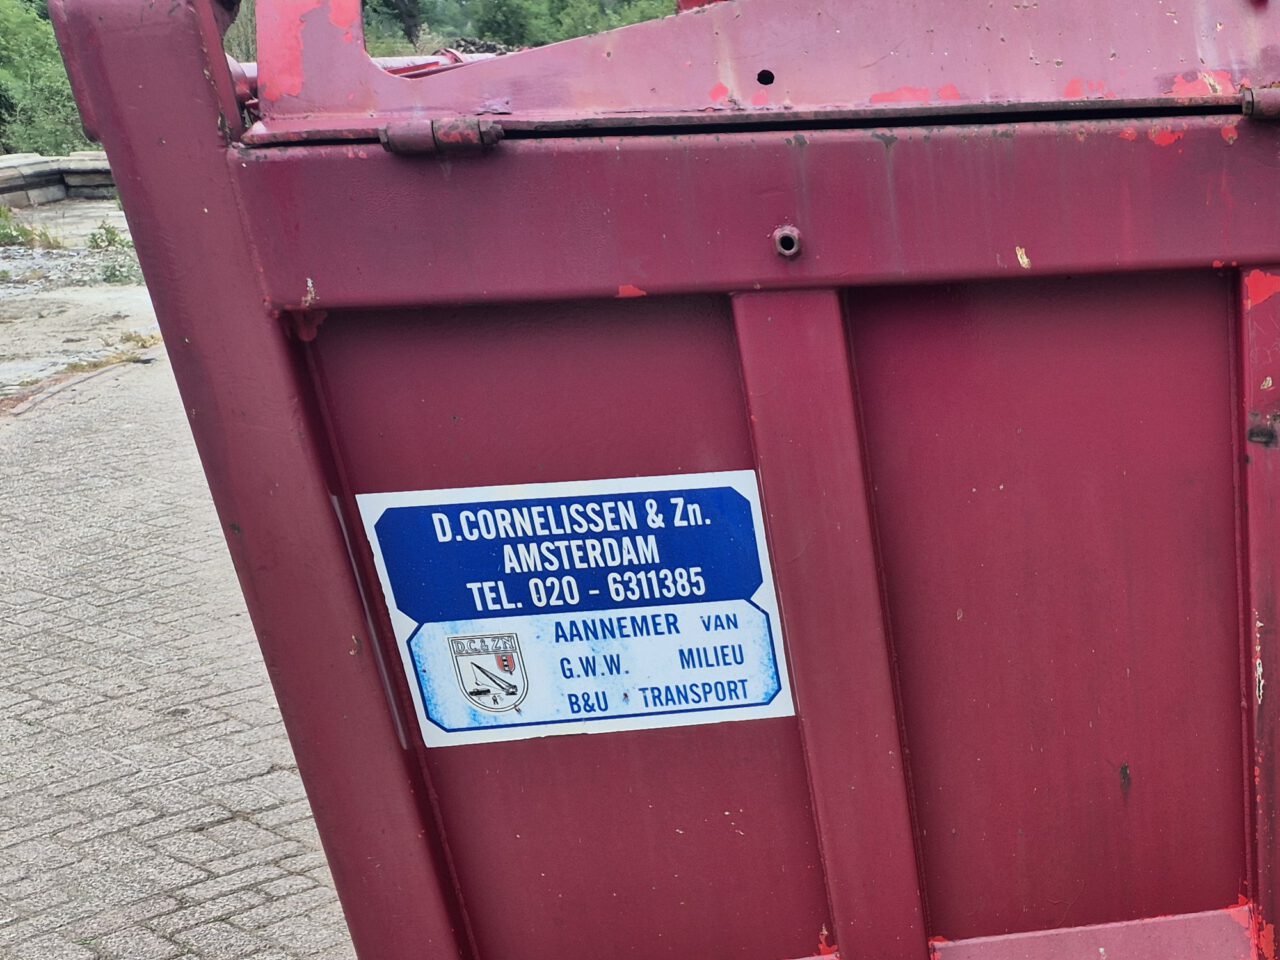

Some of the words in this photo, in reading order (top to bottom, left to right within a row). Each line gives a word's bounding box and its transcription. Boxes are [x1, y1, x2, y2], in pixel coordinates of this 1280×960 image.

[432, 501, 636, 543] D.CORNELISSEN
[647, 499, 665, 529] &
[671, 497, 711, 526] Zn.
[503, 535, 660, 573] AMSTERDAM
[467, 581, 522, 611] TEL.
[530, 576, 579, 607] 020
[609, 567, 706, 601] 6311385
[554, 613, 680, 643] AANNEMER
[700, 613, 738, 632] VAN
[560, 654, 629, 679] G.W.W.
[679, 644, 745, 670] MILIEU
[569, 691, 609, 714] B&U
[638, 679, 748, 708] TRANSPORT
